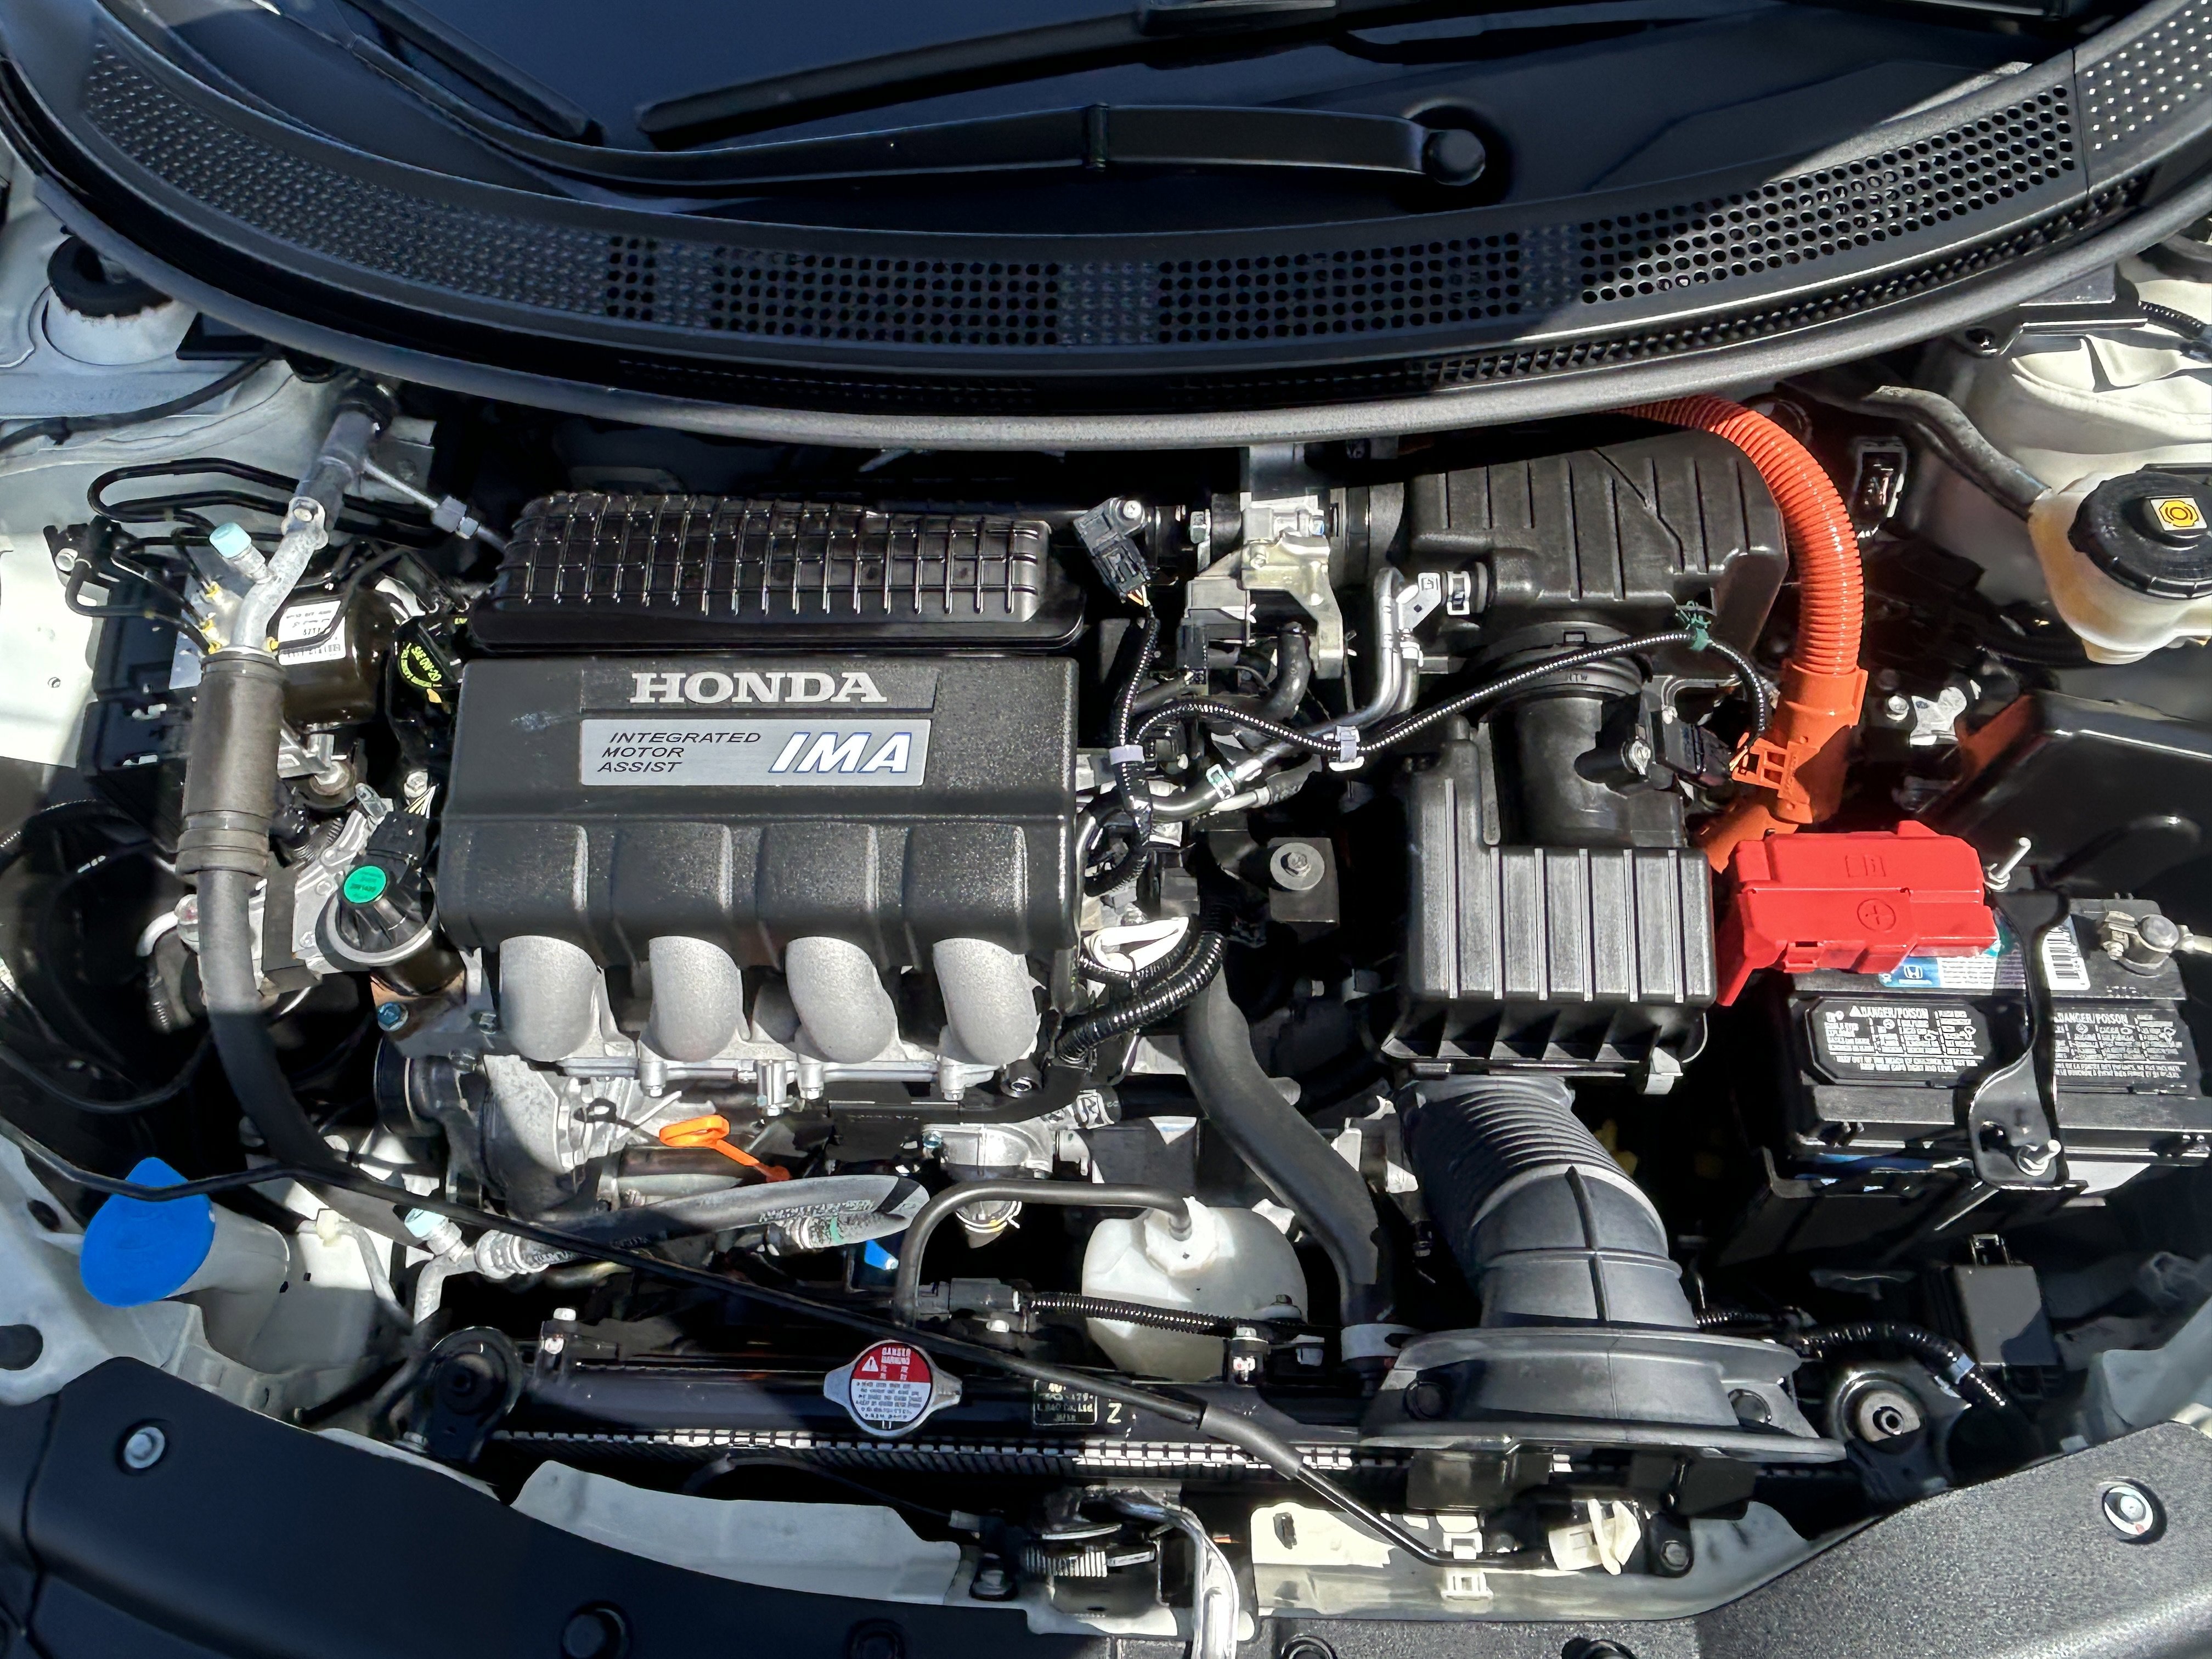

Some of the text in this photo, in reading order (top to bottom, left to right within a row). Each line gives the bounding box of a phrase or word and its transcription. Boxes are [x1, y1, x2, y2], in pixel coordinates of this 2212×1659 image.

[629, 672, 887, 704] HONDA
[609, 732, 761, 743] INTEGRATED
[602, 747, 685, 758] MOTOR
[768, 731, 912, 774] IMA
[597, 761, 682, 773] ASSIST
[1107, 1402, 1122, 1424] Z
